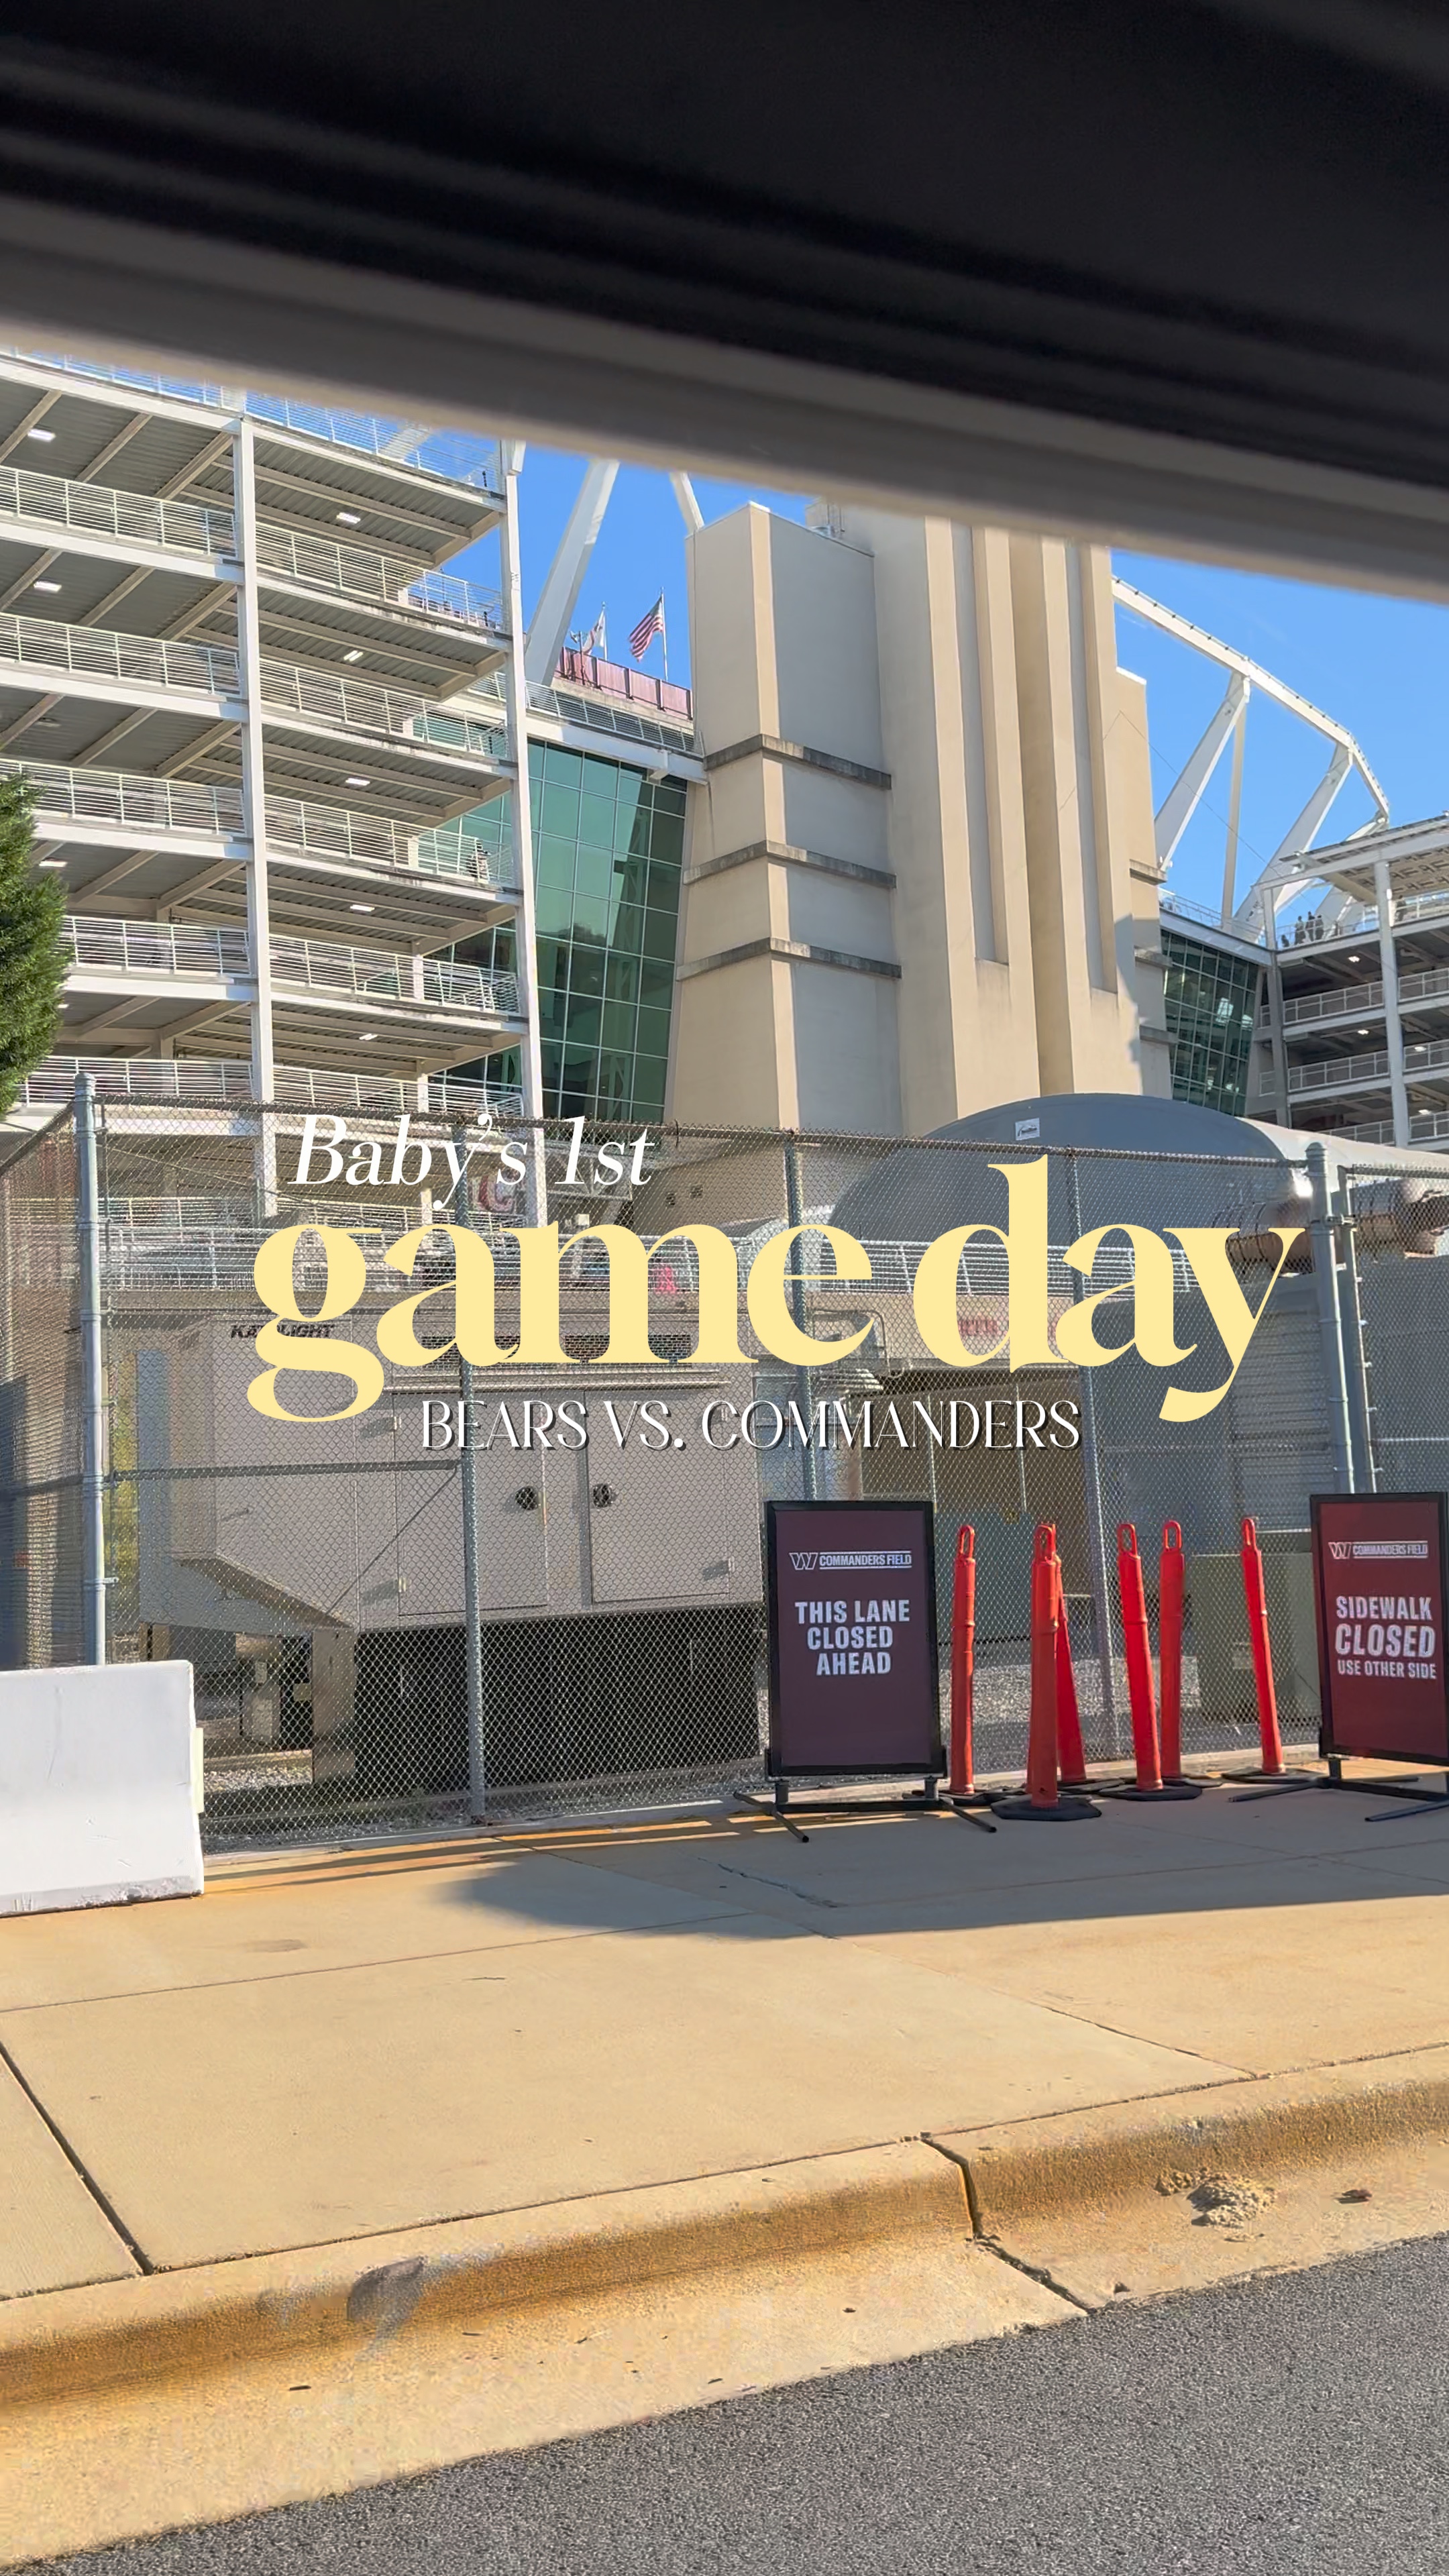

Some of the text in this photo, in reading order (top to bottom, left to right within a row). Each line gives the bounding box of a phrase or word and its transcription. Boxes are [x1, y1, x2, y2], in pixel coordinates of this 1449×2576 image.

[819, 1554, 885, 1566] COMMANDERS
[886, 1554, 912, 1565] FIELD
[1352, 1545, 1406, 1555] COMMANDERS
[1407, 1544, 1428, 1554] FIELD
[794, 1599, 910, 1624] THIS LANE
[1336, 1595, 1433, 1621] SIDEWALK
[807, 1625, 894, 1650] CLOSED
[1335, 1623, 1436, 1658] CLOSED
[816, 1652, 892, 1676] AHEAD
[1338, 1659, 1438, 1680] USE OTHER SIDE
